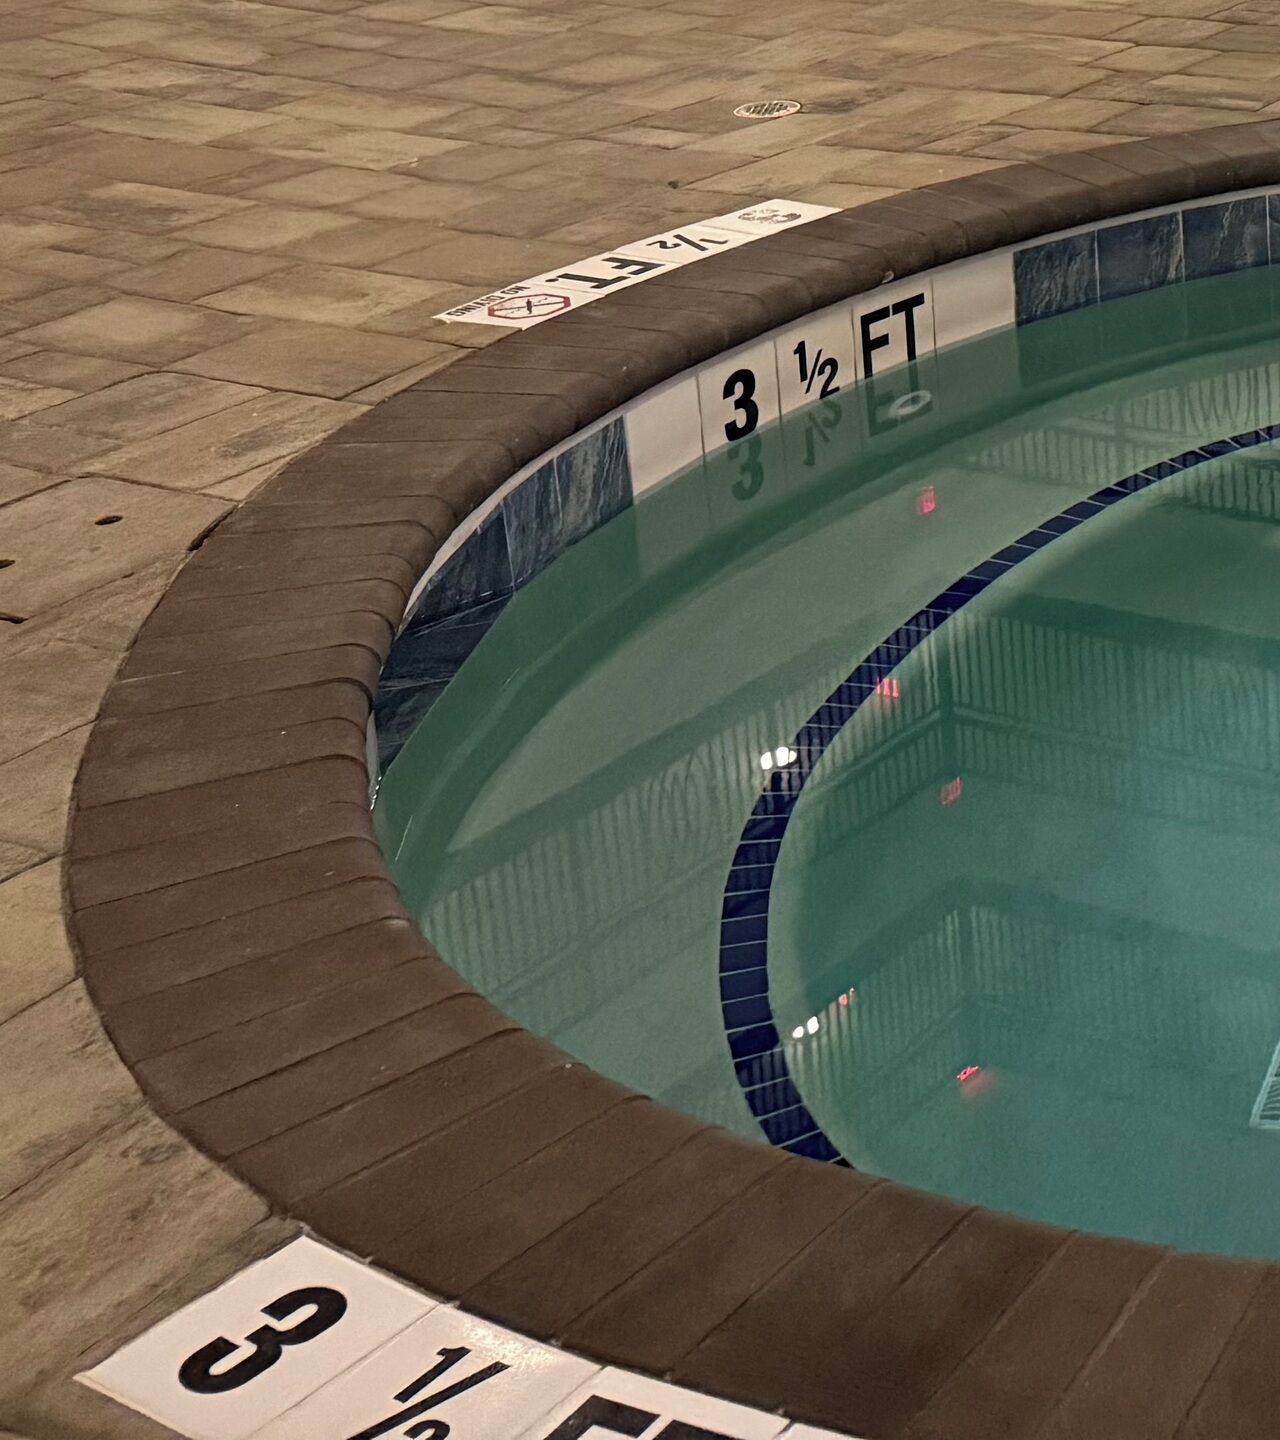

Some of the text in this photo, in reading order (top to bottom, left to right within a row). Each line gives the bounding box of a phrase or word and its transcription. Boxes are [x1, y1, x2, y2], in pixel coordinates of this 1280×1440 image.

[722, 368, 759, 442] 3
[860, 292, 925, 380] FT
[179, 1286, 348, 1394] 3
